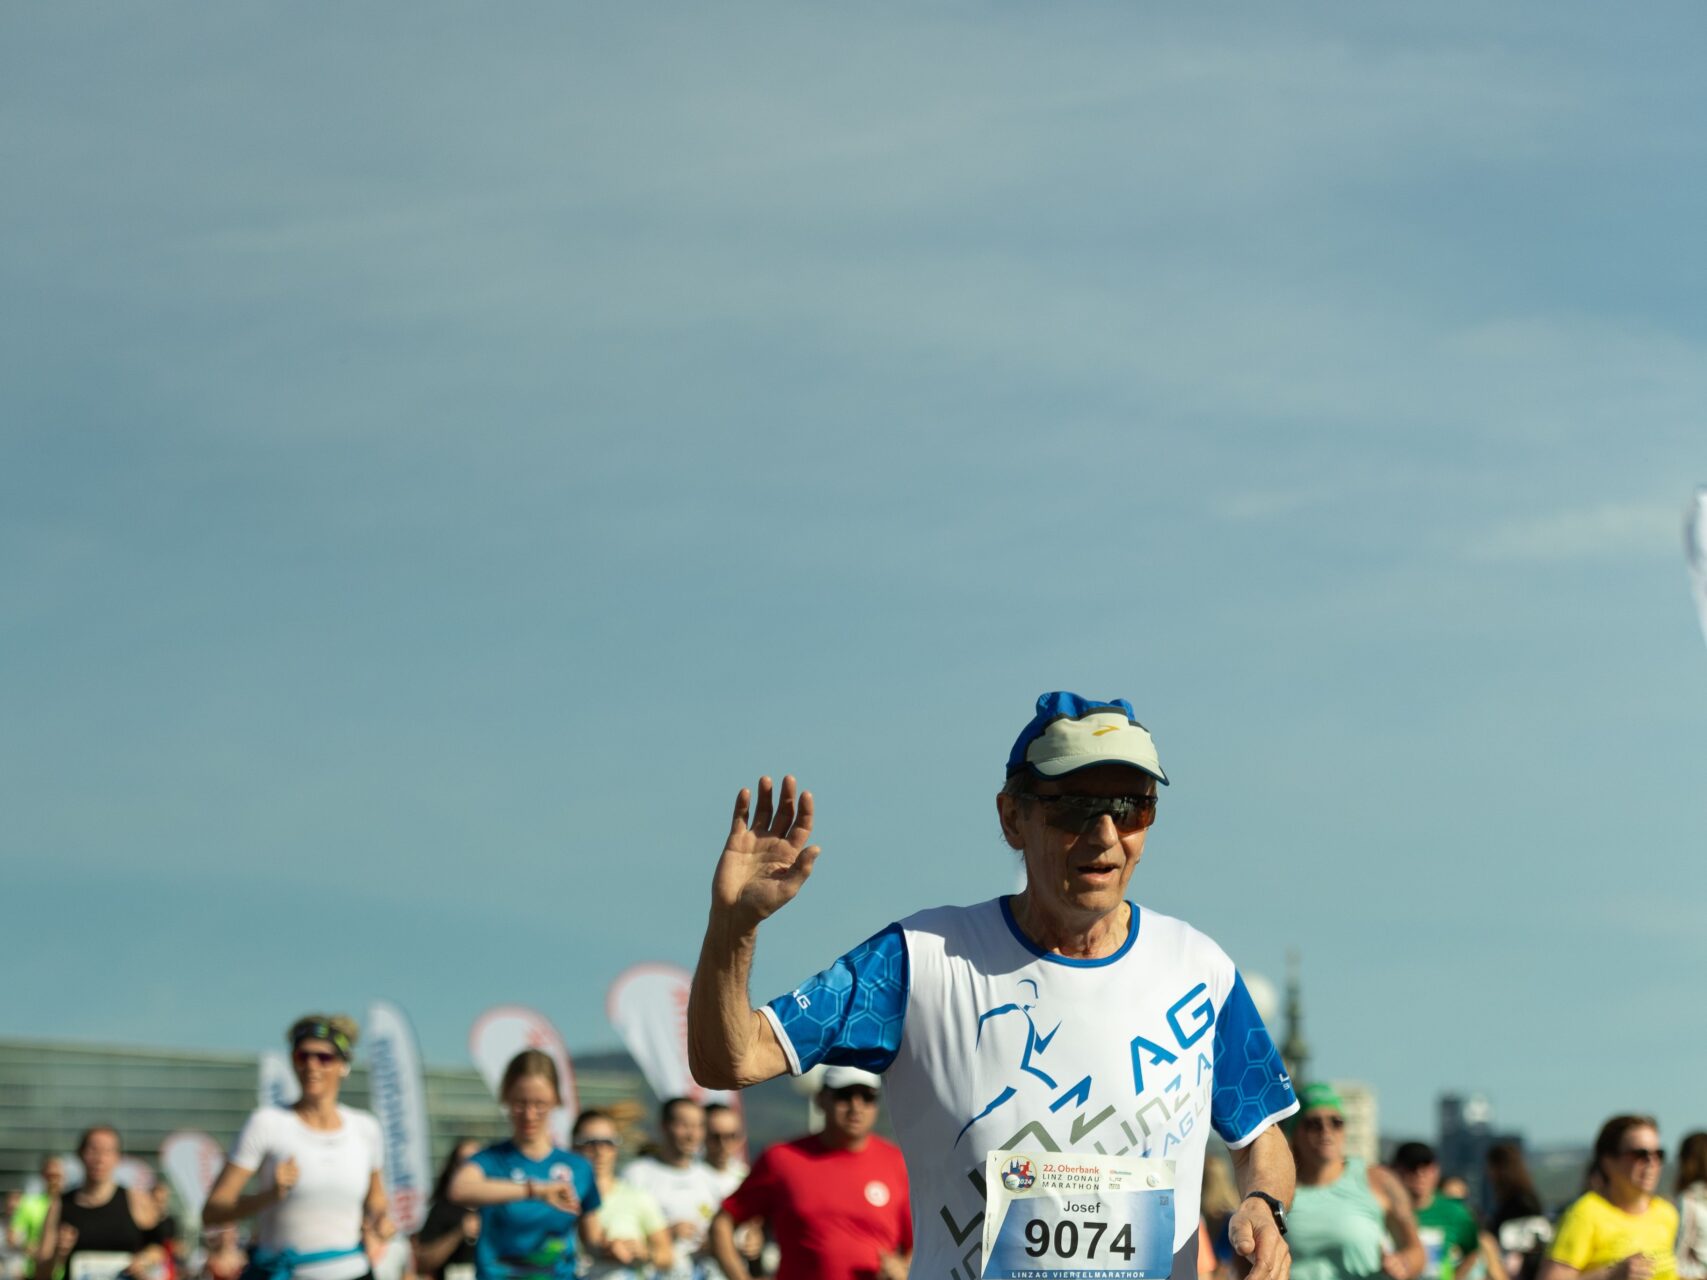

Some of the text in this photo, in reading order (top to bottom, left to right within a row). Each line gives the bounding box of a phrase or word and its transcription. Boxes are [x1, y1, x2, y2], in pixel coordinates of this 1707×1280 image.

[1130, 982, 1216, 1097] AG
[1042, 1164, 1056, 1173] 22.
[1057, 1164, 1100, 1175] Oberbank
[1042, 1173, 1063, 1181] LINZ
[1067, 1174, 1100, 1182] DONAU
[1042, 1181, 1100, 1190] MARATHON
[1063, 1201, 1101, 1213] Josef
[1025, 1218, 1136, 1261] 9074
[1053, 1271, 1145, 1279] VIERTELMARATHON
